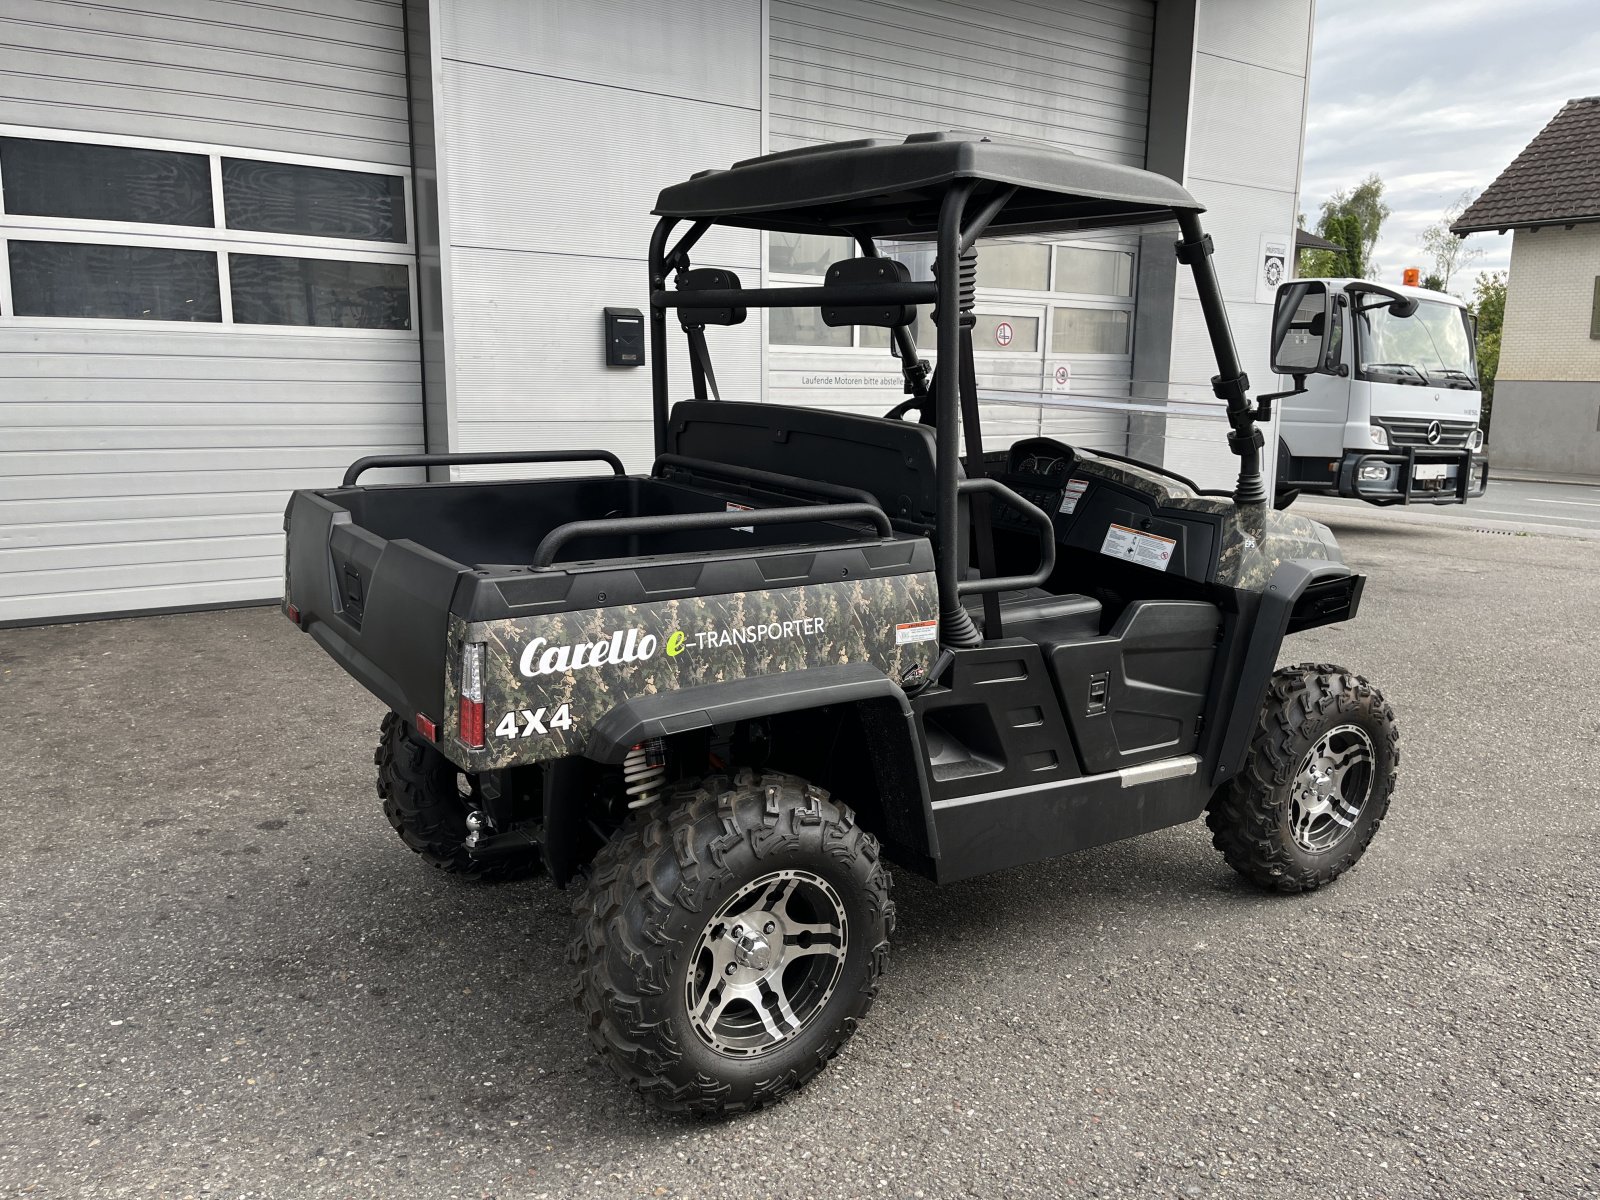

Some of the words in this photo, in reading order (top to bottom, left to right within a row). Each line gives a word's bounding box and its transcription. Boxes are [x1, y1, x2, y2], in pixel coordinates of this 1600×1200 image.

[802, 376, 833, 385] Laufende
[835, 377, 862, 385] Motoren
[864, 377, 879, 385] bitte
[880, 378, 904, 386] abstelle
[519, 628, 657, 677] Carello
